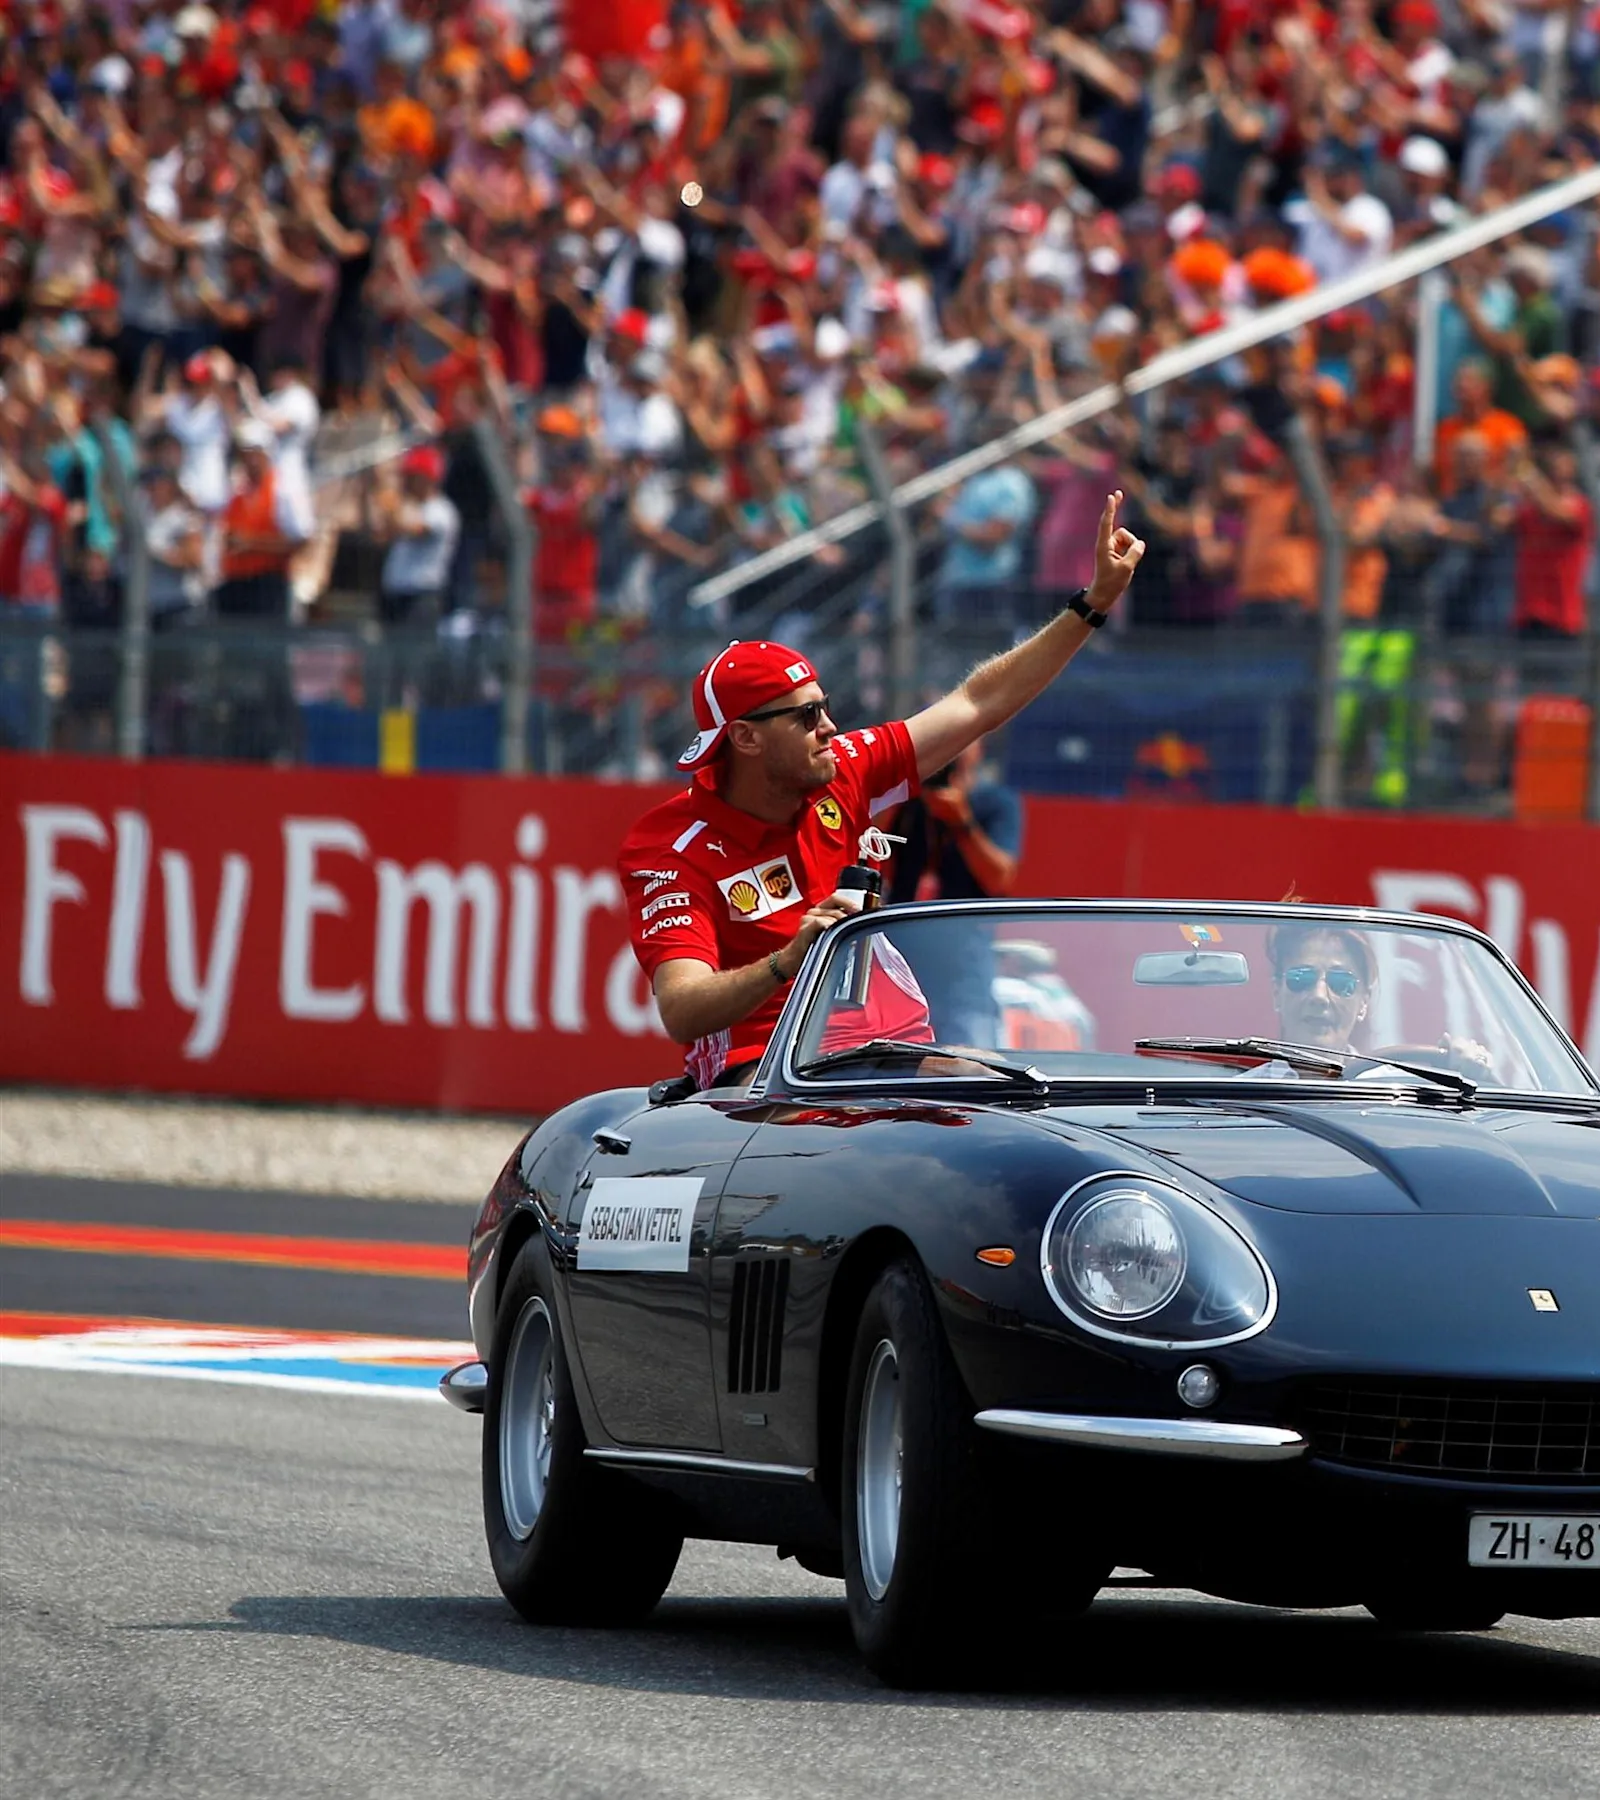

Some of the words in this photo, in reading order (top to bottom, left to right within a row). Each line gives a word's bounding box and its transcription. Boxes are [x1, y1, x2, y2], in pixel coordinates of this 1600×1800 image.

[764, 874, 790, 896] ups
[20, 804, 250, 1062] Fly
[641, 914, 692, 940] Lenovo
[588, 1206, 645, 1241] SEBASTIAN
[644, 1208, 682, 1243] VETTEL
